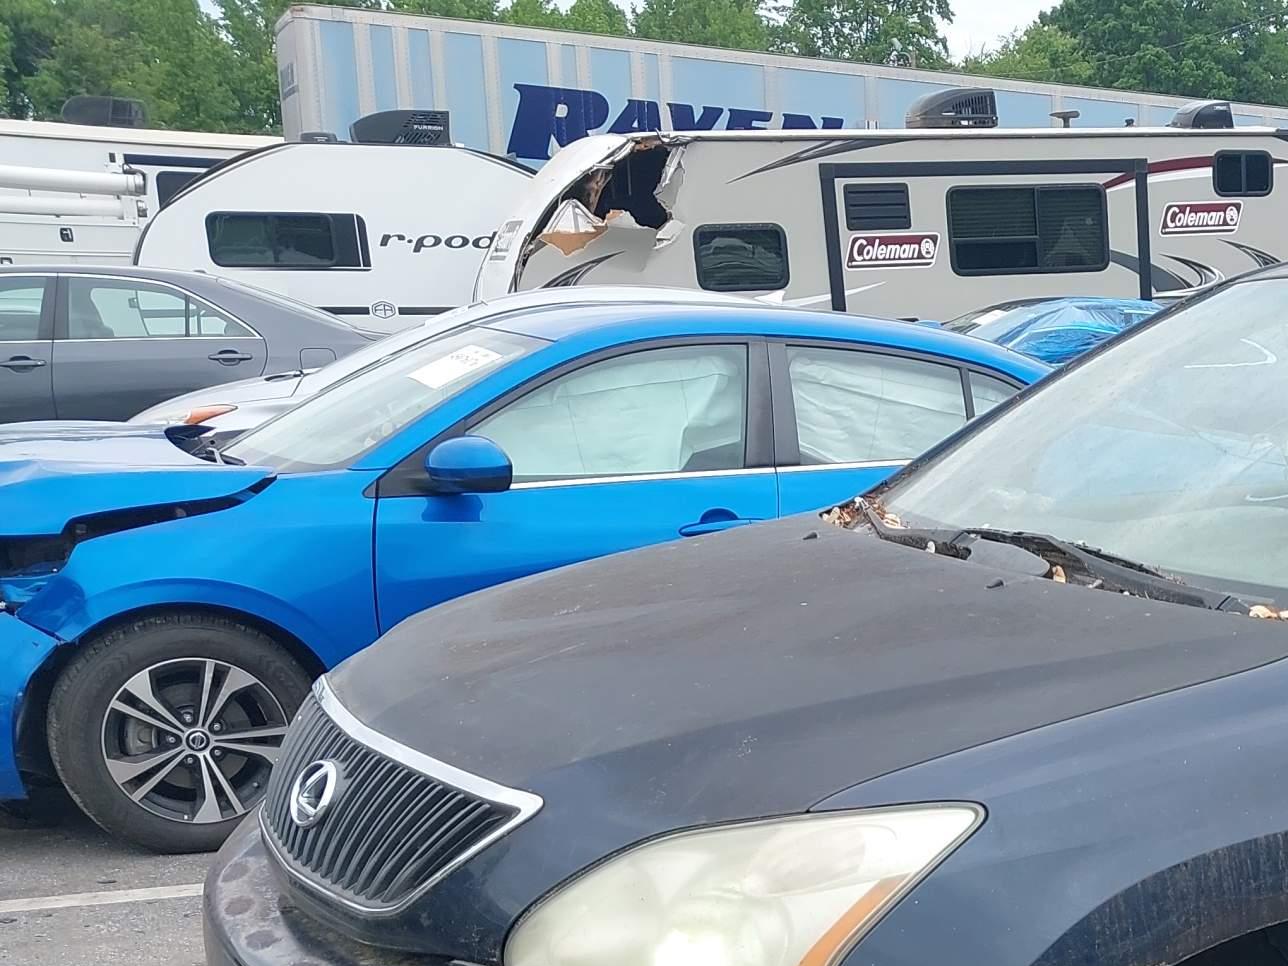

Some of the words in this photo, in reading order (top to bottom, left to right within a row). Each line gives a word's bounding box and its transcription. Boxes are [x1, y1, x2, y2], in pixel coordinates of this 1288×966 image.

[507, 83, 844, 160] RAV
[1166, 206, 1225, 228] Coleman
[853, 238, 919, 261] Coleman
